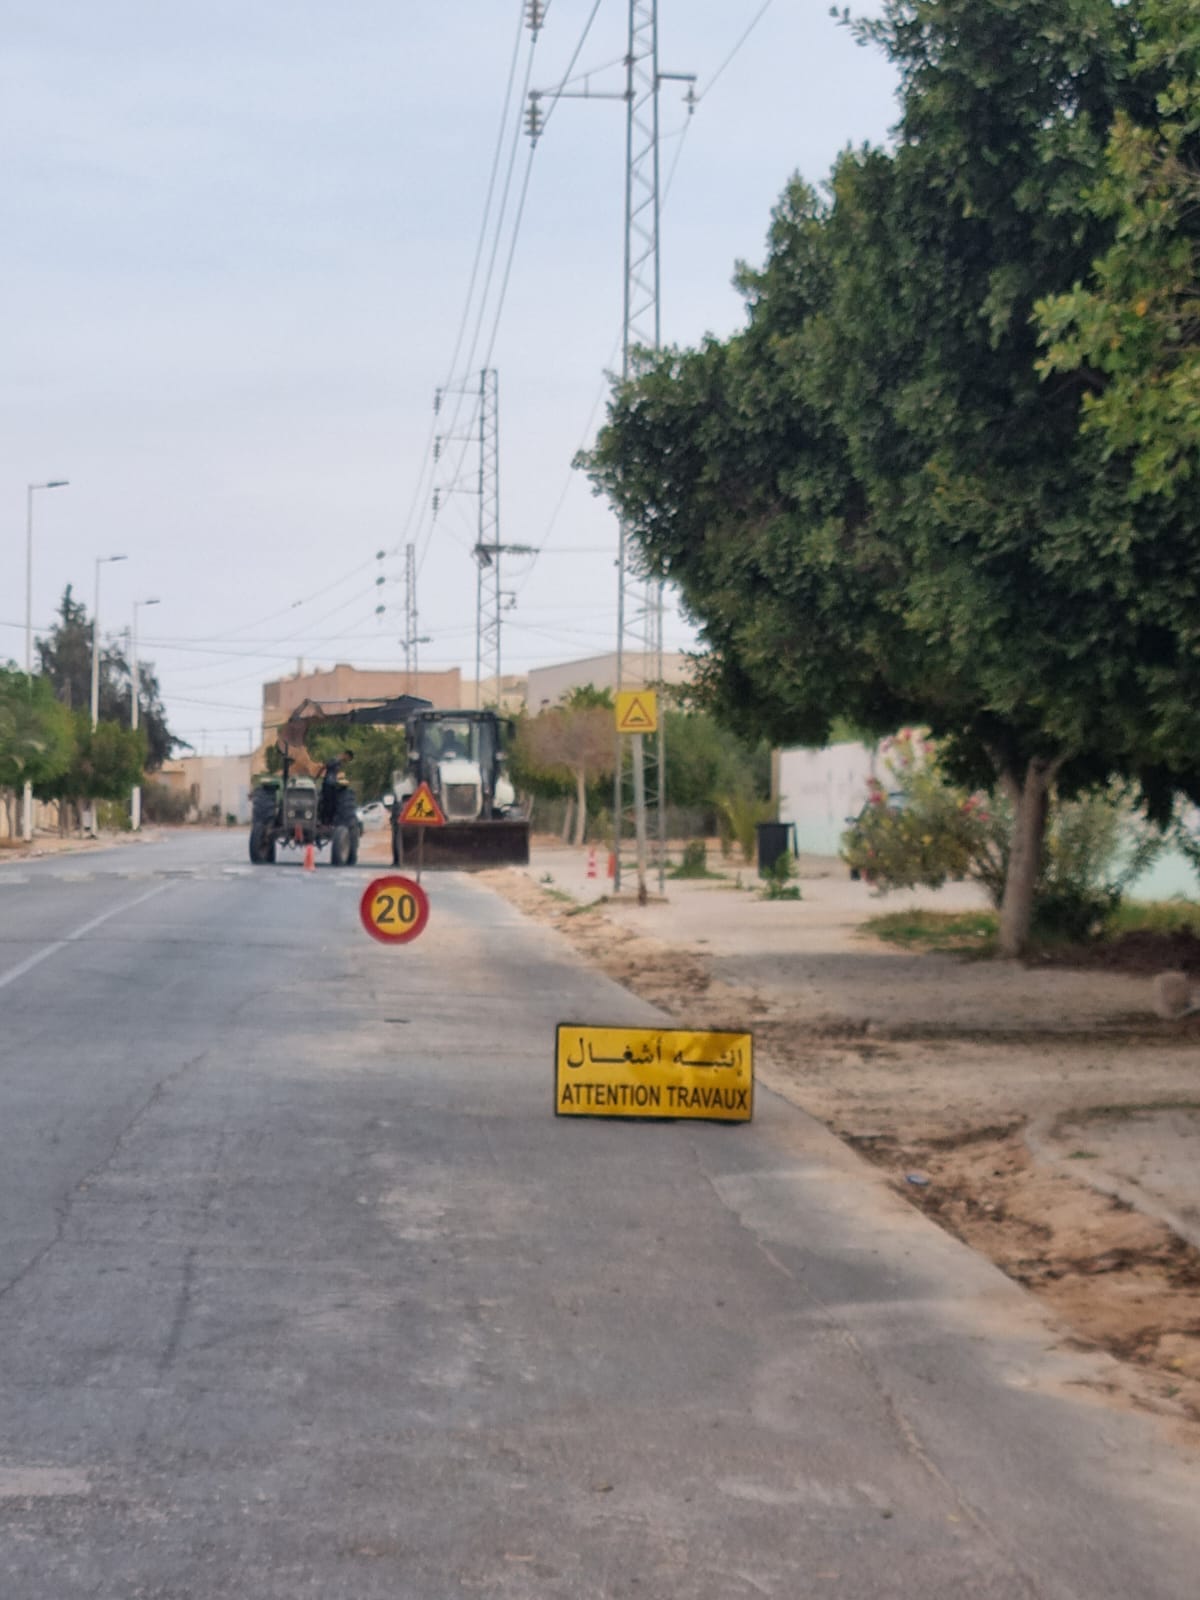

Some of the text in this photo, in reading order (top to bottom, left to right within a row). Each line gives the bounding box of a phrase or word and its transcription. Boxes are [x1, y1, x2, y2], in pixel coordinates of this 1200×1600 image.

[376, 894, 416, 923] 20
[562, 1083, 748, 1111] ATTENTION TRAVAUX
